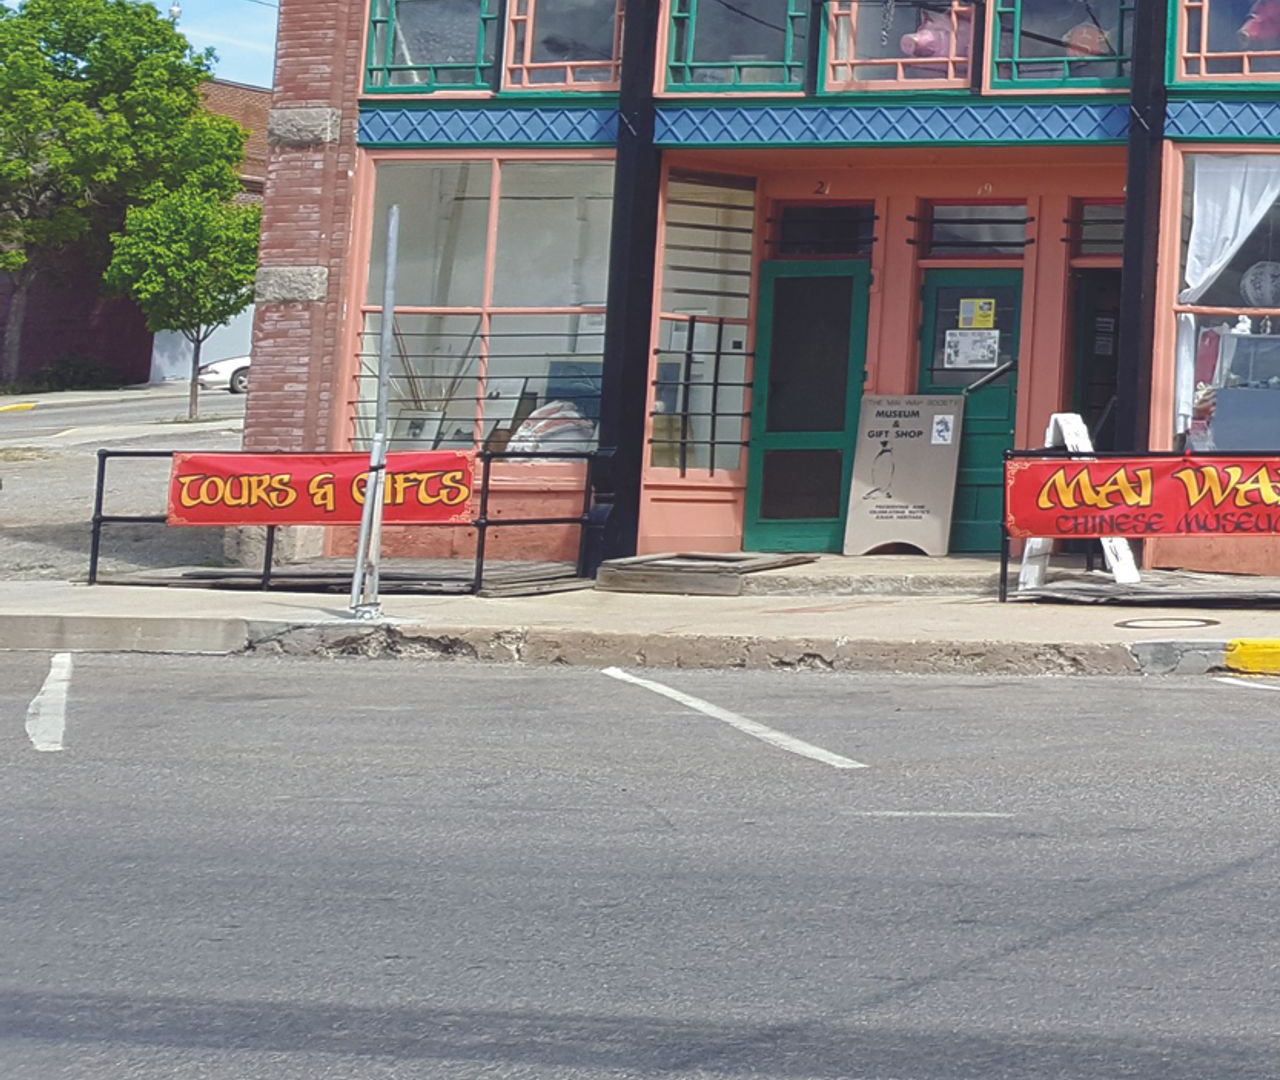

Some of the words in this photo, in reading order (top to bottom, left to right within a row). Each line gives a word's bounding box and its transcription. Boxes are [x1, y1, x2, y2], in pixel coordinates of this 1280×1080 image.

[875, 410, 920, 418] MUSEUM
[892, 420, 900, 428] &
[867, 430, 889, 438] GIFT
[895, 430, 924, 438] SHOP
[177, 474, 297, 508] TOURS
[1036, 466, 1153, 510] MAI
[1055, 512, 1166, 535] CHINESE
